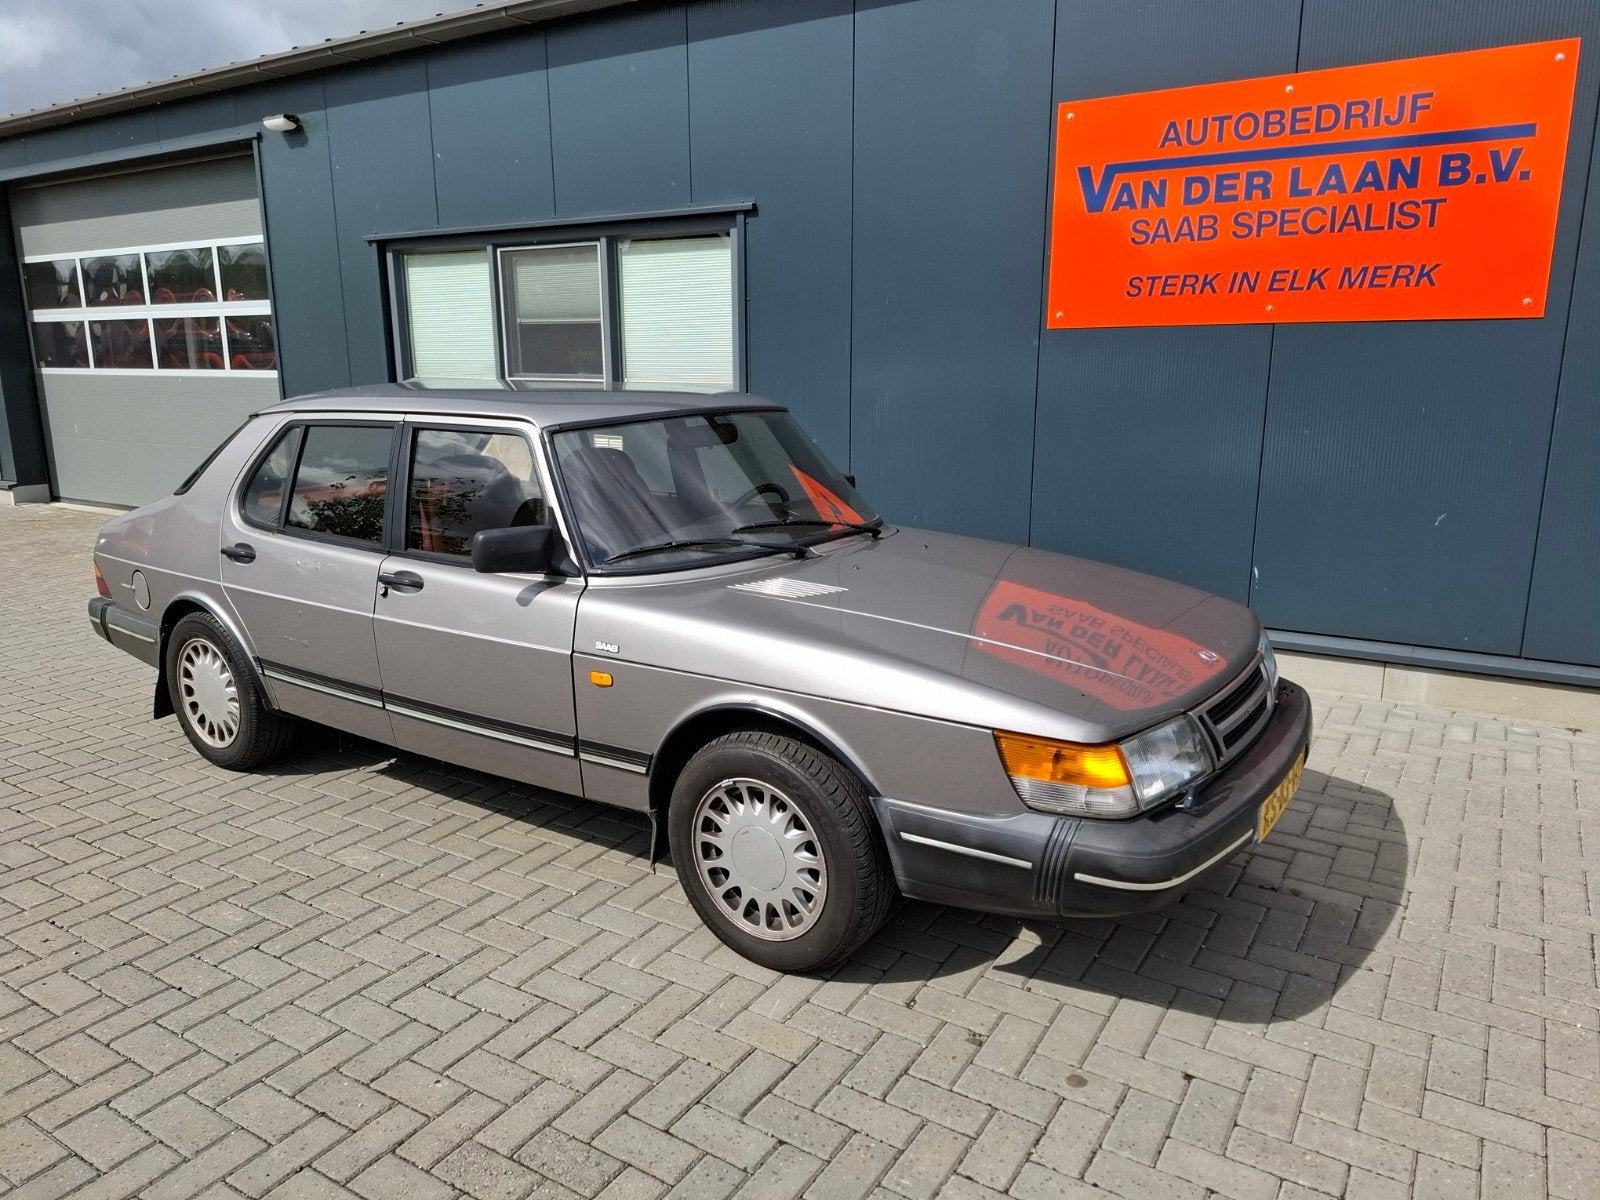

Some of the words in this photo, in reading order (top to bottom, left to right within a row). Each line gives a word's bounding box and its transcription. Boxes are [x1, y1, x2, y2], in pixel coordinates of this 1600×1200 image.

[1160, 92, 1434, 149] AUTOBEDRIJF
[1077, 164, 1168, 213] VAN
[1182, 170, 1273, 206] DER
[1289, 156, 1420, 198] LAAN
[1438, 147, 1531, 187] B.V.
[1130, 211, 1219, 246] SAAB
[1231, 197, 1448, 240] SPECIALIST
[1126, 272, 1222, 298] STERK
[1228, 270, 1261, 293] IN
[1267, 267, 1331, 291] ELK
[1337, 263, 1442, 290] MERK
[595, 641, 619, 653] SAAB
